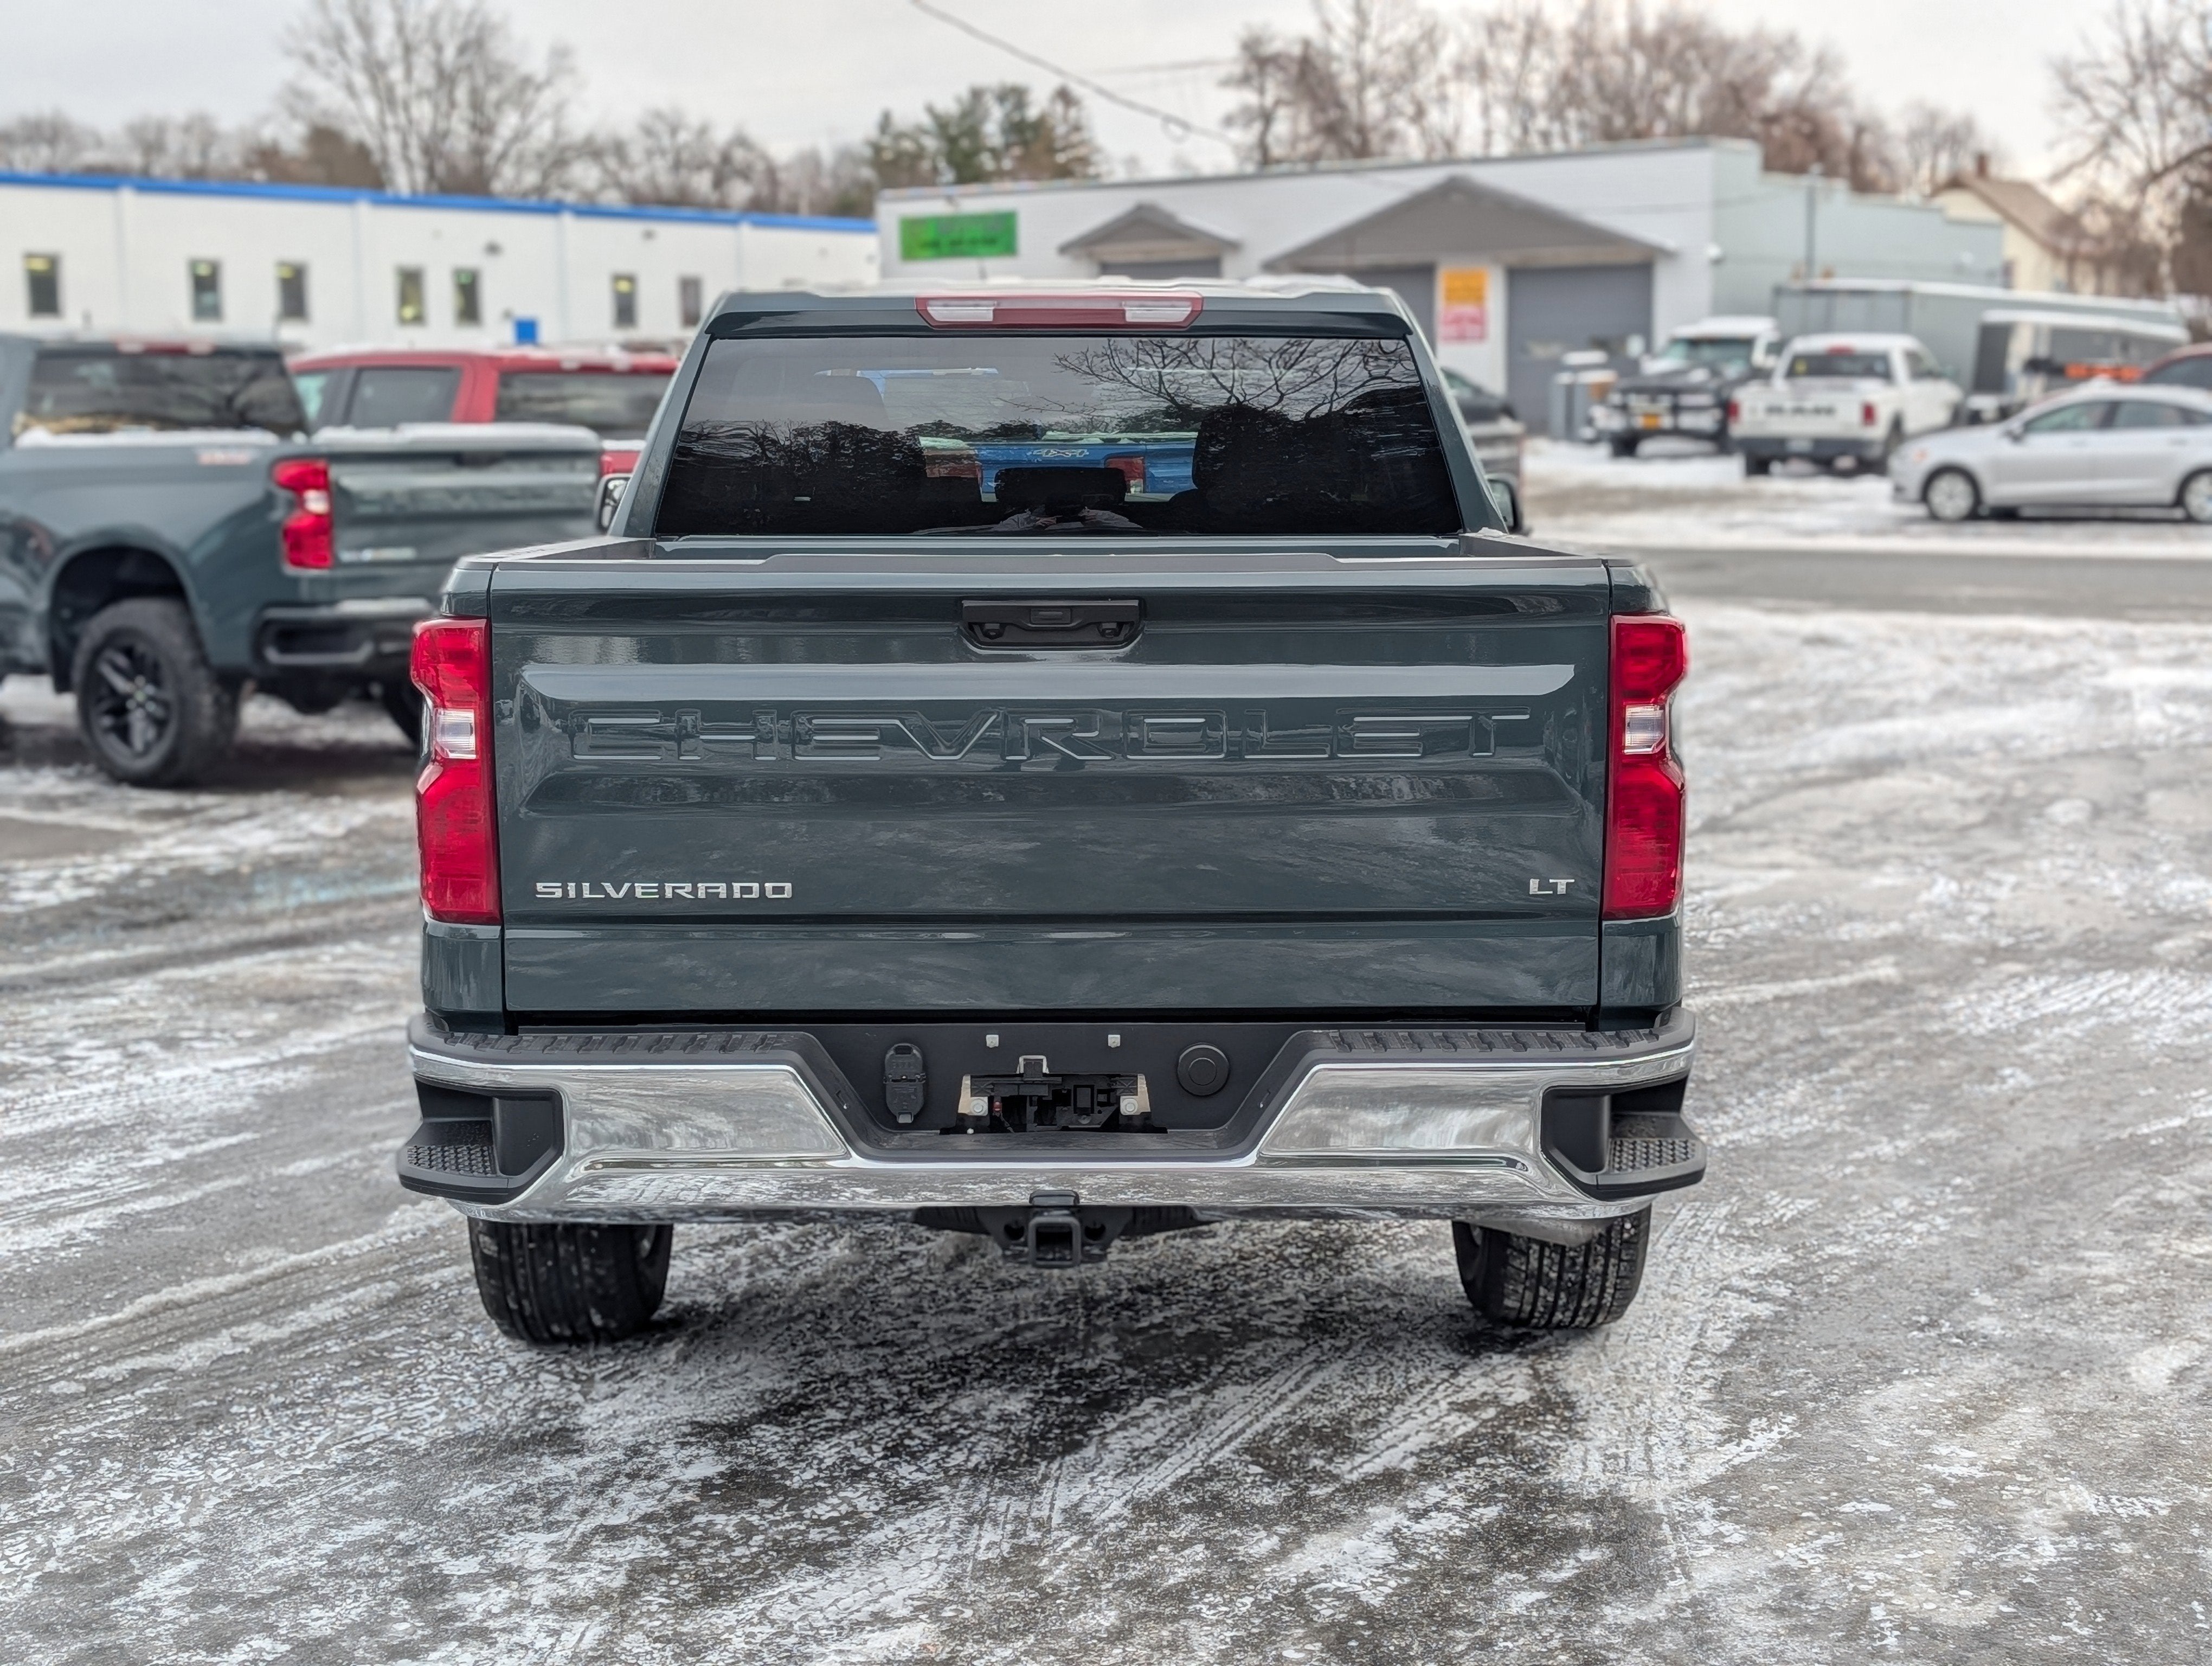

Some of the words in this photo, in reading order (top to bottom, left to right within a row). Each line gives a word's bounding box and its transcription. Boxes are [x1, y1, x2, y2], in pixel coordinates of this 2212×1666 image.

[567, 708, 1530, 760] CHEVROLET
[535, 882, 793, 899] SILVERADO
[1529, 879, 1575, 894] LT
